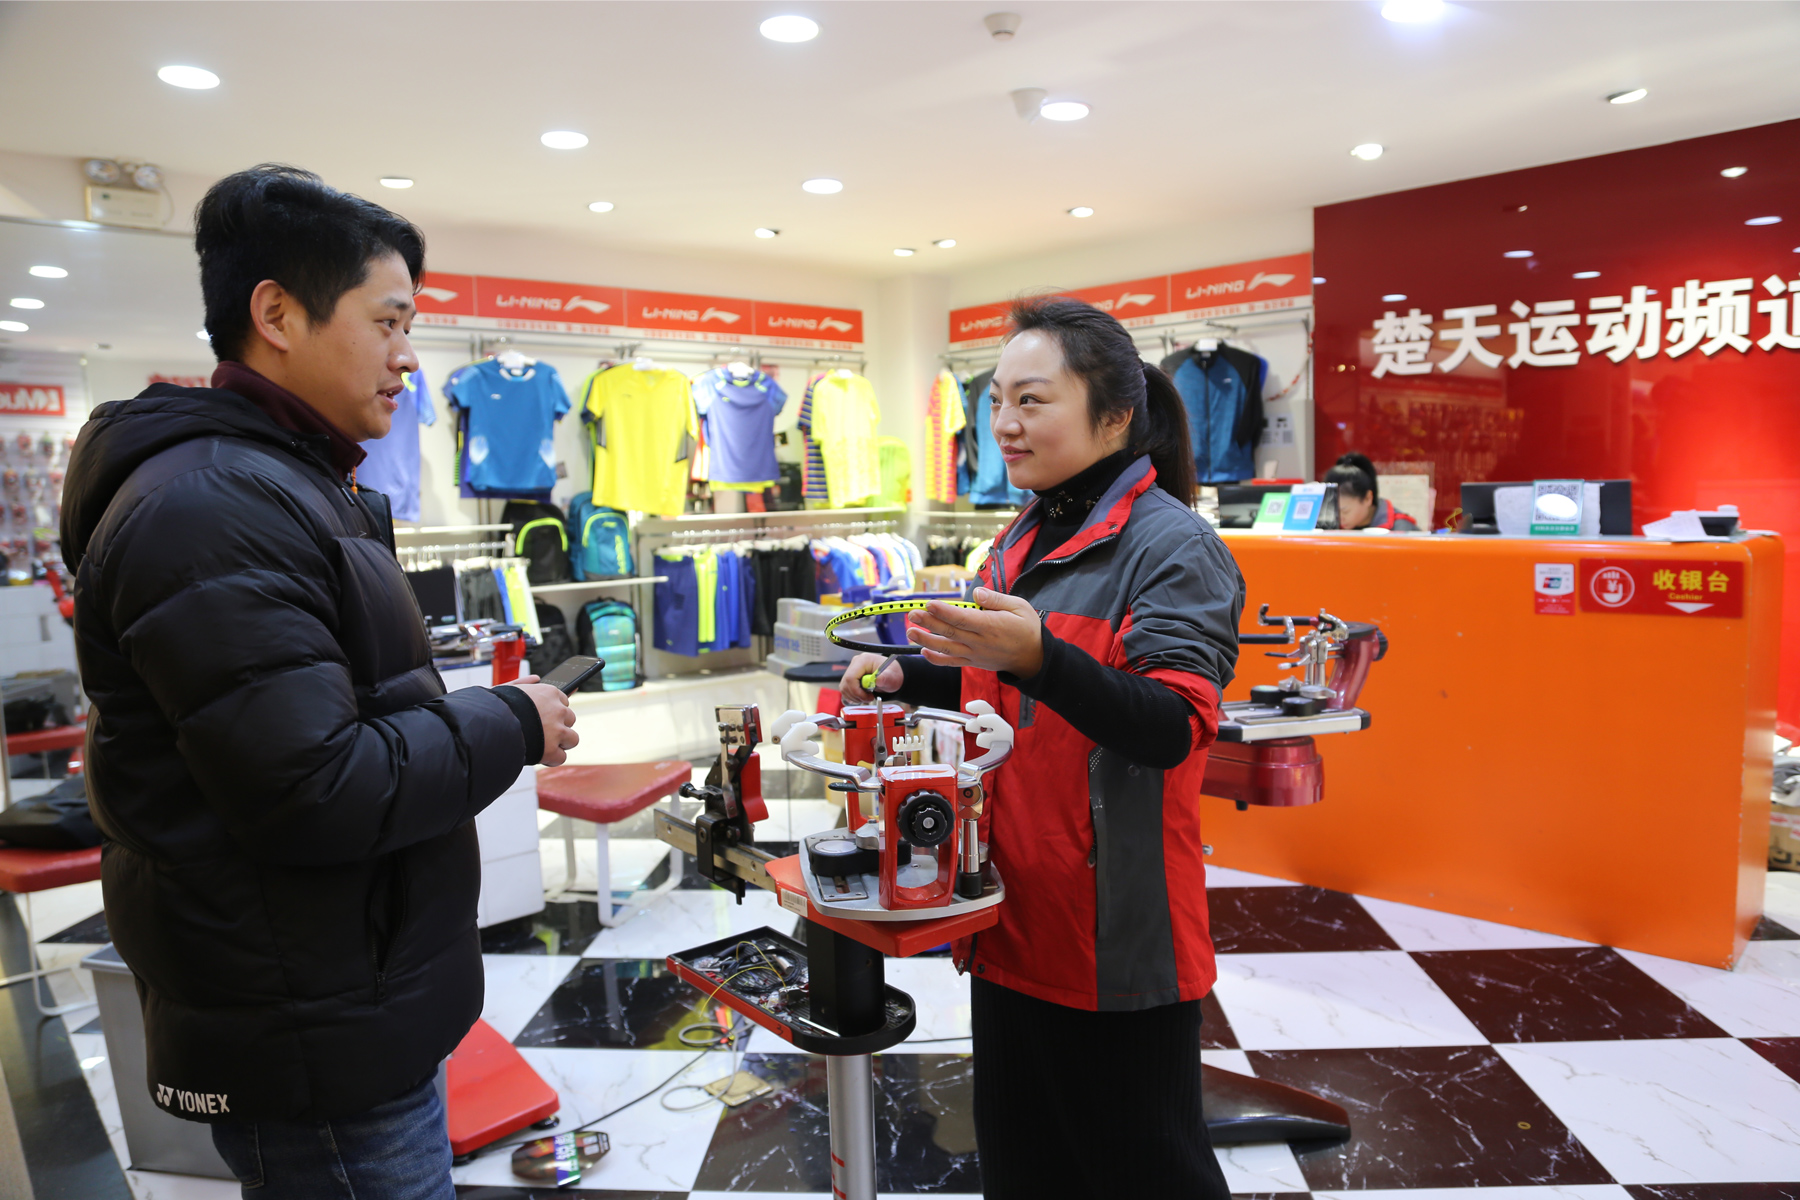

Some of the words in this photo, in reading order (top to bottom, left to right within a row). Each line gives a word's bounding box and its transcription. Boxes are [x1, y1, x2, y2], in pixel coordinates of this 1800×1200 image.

[1185, 280, 1246, 299] LI-NING
[496, 294, 562, 311] LI-NING
[642, 307, 699, 321] LI-NING
[768, 316, 818, 330] LI-NING
[1652, 569, 1730, 593] 收银台
[176, 1089, 230, 1114] YONEX
